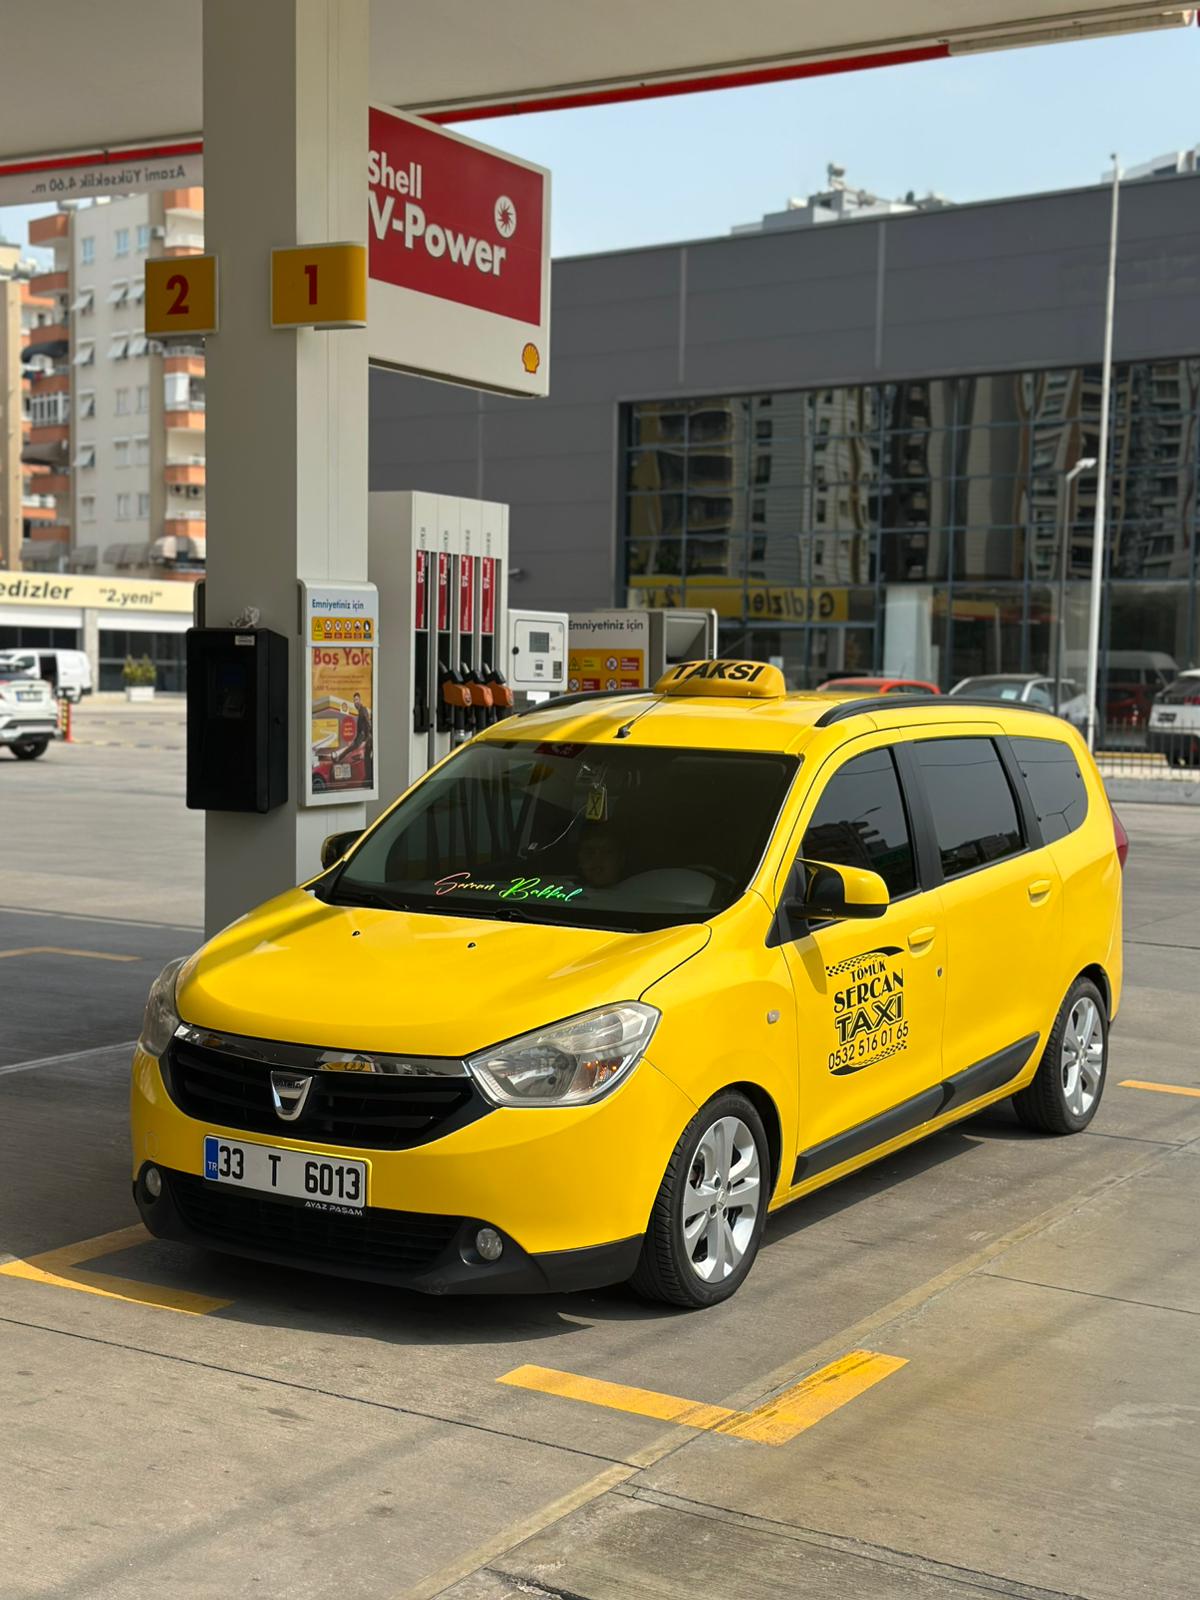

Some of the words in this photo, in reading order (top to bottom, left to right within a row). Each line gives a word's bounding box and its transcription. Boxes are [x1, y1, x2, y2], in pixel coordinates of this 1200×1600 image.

[367, 150, 423, 200] Shell
[368, 190, 507, 277] V-Power
[165, 274, 190, 316] 2
[304, 264, 318, 305] 1
[312, 599, 351, 611] Emniyetiniz
[352, 600, 365, 612] için
[568, 619, 625, 633] Emniyetiniz
[626, 620, 644, 633] için
[313, 647, 339, 671] Boş
[343, 647, 371, 667] Yok
[672, 663, 766, 683] TAKSI
[833, 968, 904, 1014] SERCAN
[850, 960, 887, 983] TÖMÜK
[834, 991, 904, 1047] TAXI
[828, 1043, 855, 1070] 0532
[858, 1034, 878, 1057] 516
[881, 1027, 893, 1047] 01
[896, 1020, 909, 1040] 65
[207, 1160, 218, 1172] TR
[218, 1145, 244, 1180] 33
[268, 1154, 282, 1187] T
[304, 1161, 361, 1201] 6013
[304, 1200, 328, 1211] AYAZ
